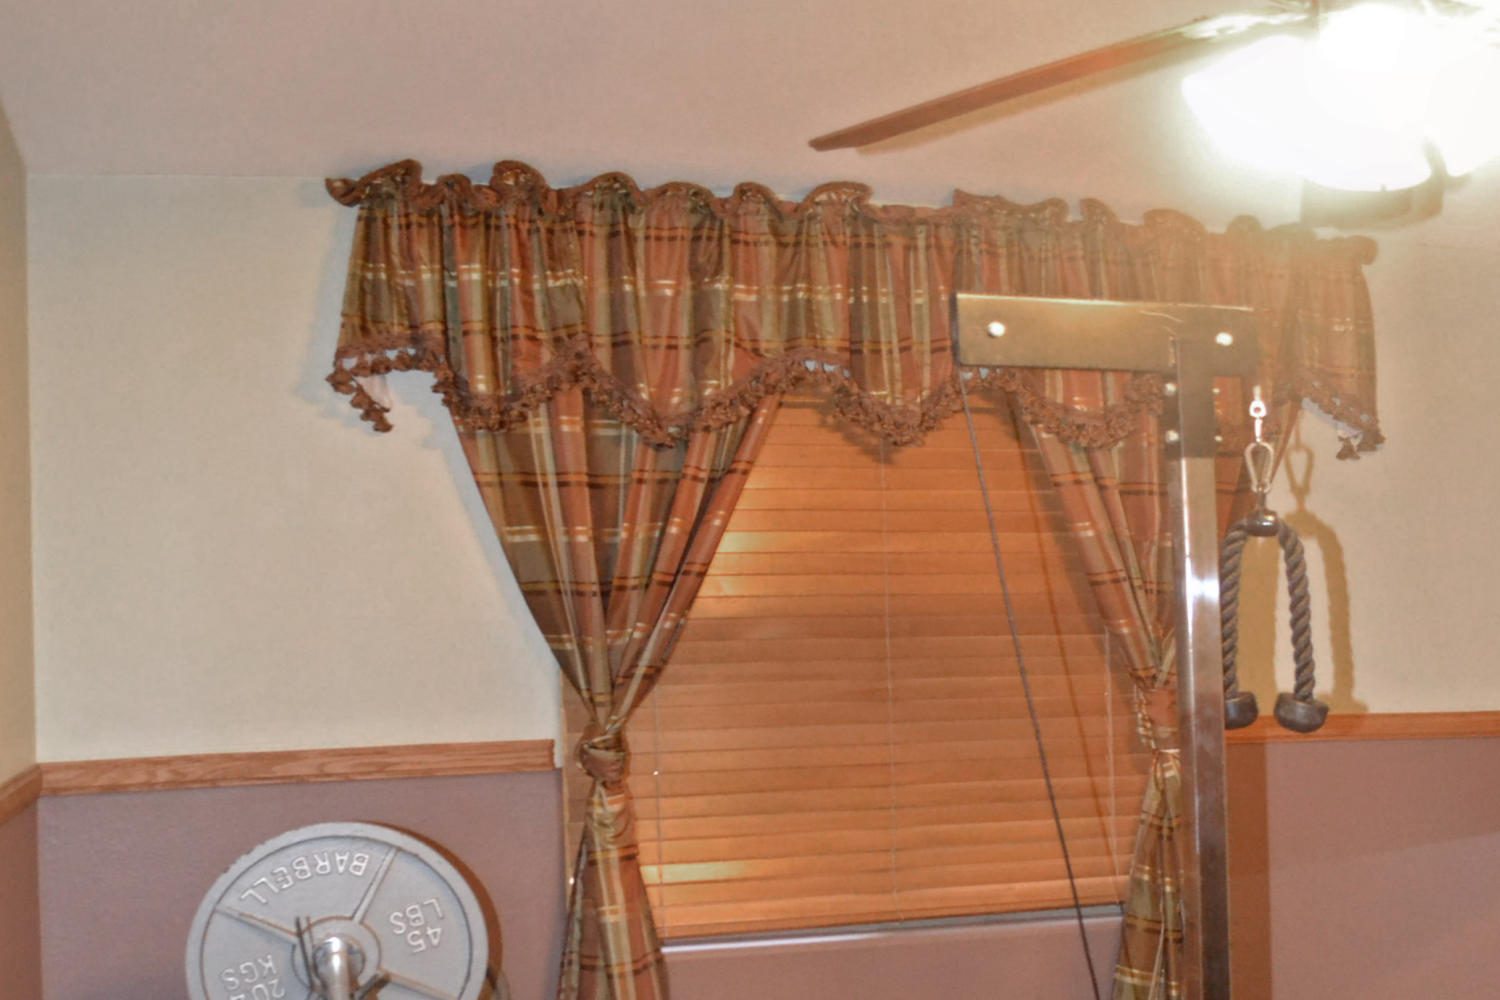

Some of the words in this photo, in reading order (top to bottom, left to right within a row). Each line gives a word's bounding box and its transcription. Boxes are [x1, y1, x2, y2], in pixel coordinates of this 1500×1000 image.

[239, 850, 370, 908] BARBELL
[389, 897, 445, 936] LBS
[407, 926, 443, 954] 45
[220, 954, 278, 991] KGS
